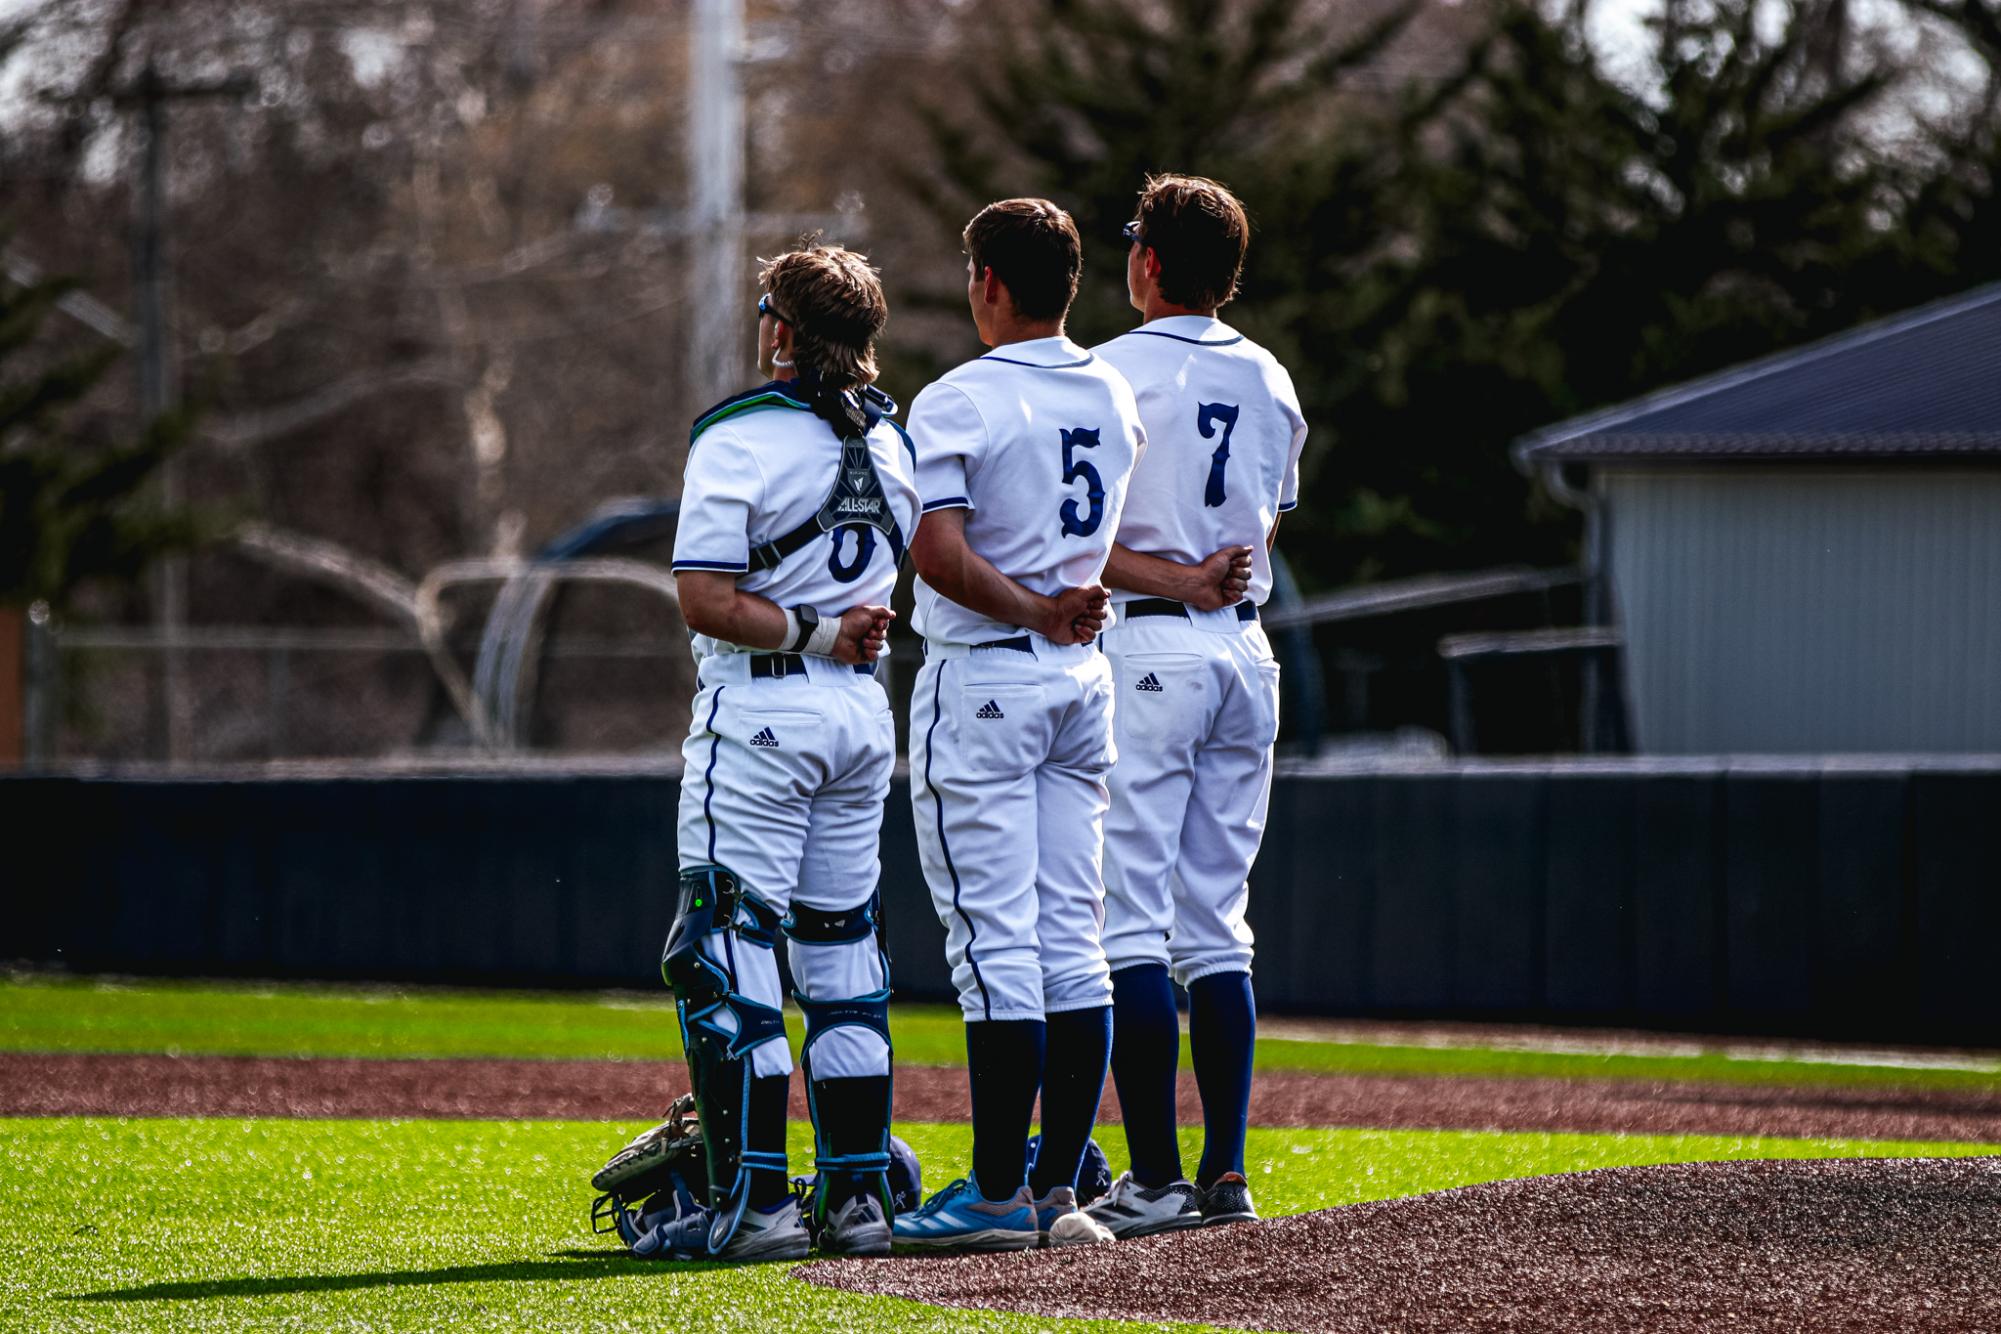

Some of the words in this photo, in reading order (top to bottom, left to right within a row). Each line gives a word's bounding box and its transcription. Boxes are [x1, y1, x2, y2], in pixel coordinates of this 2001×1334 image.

[1197, 401, 1239, 508] 7
[1059, 427, 1105, 539] 5
[837, 497, 881, 514] ALL-STAR
[1135, 683, 1164, 692] adidas
[976, 711, 1005, 719] adidas
[749, 738, 780, 748] adidas
